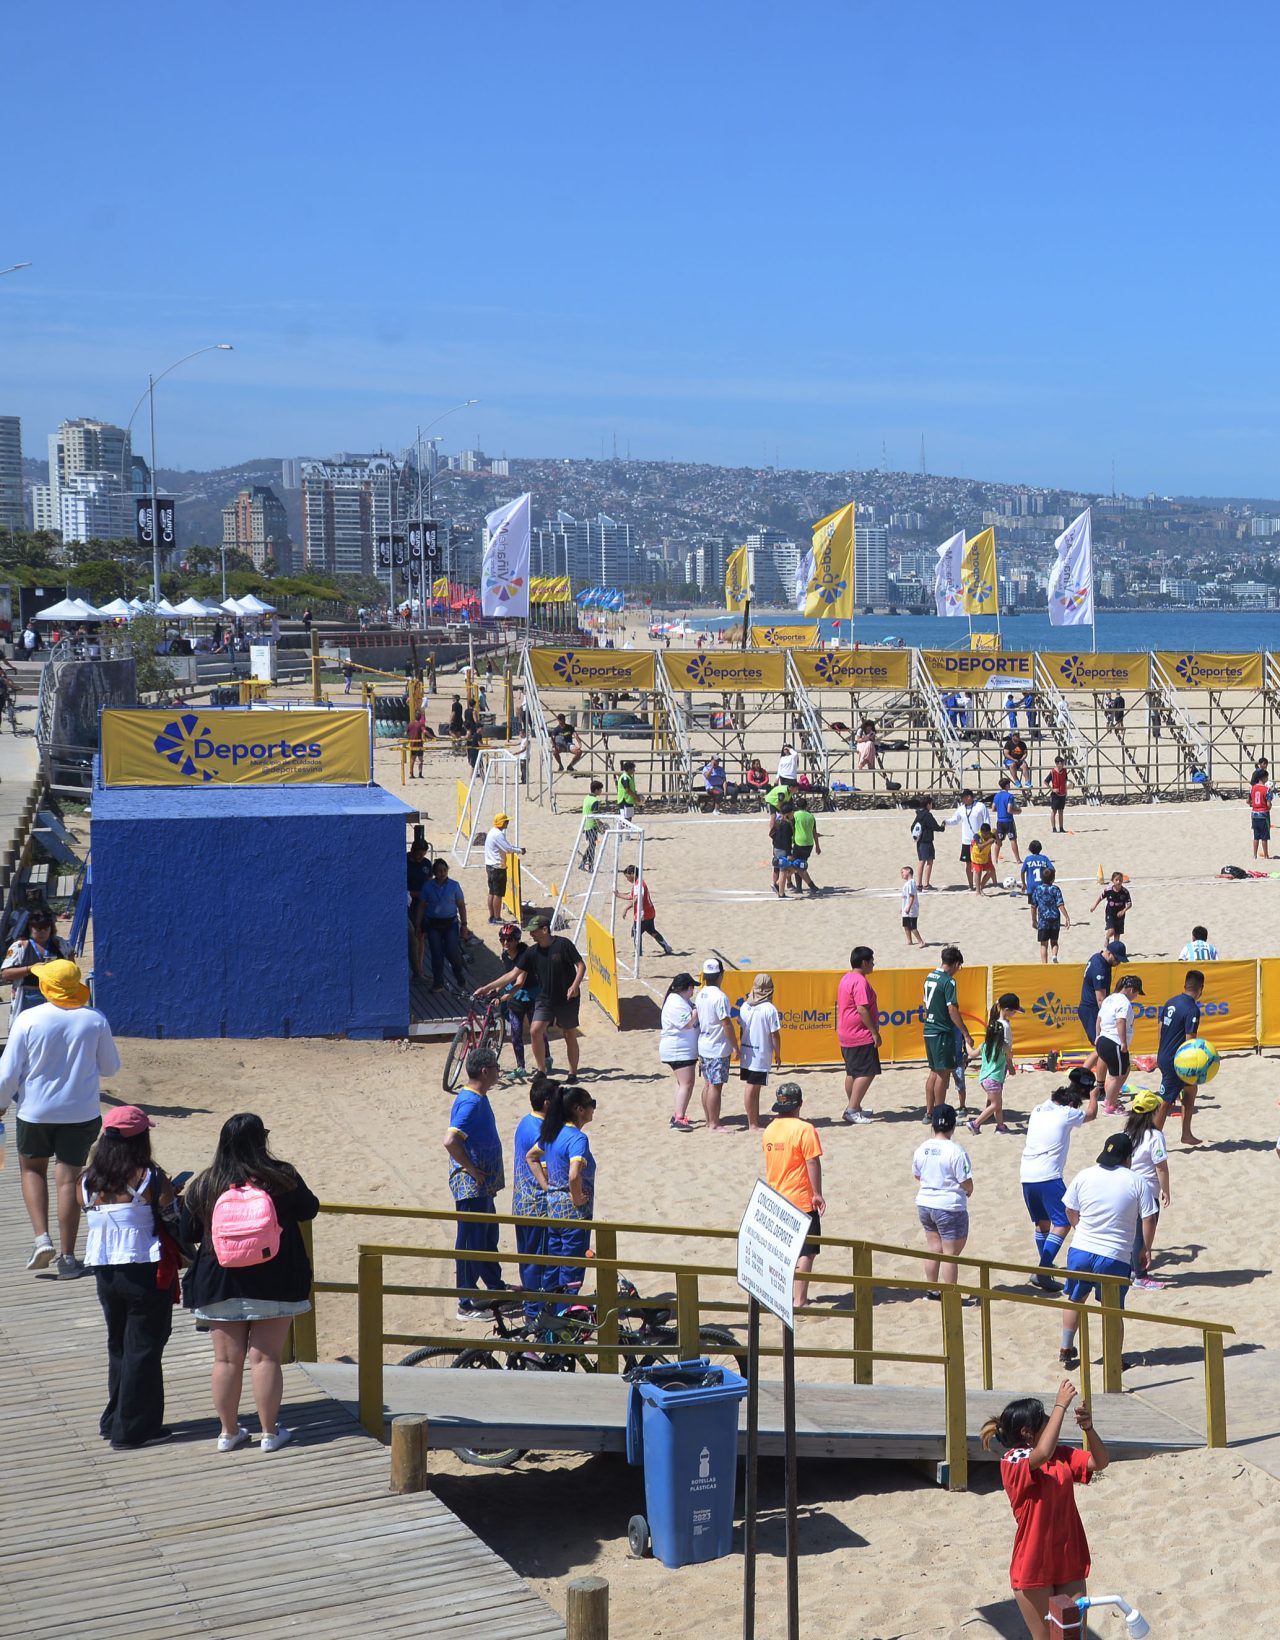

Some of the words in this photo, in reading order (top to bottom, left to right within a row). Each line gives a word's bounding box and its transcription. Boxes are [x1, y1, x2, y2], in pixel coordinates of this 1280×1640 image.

[571, 664, 632, 678] Deportes
[831, 664, 888, 678] Deportes
[945, 657, 1030, 672] DEPORTE
[1076, 665, 1129, 678] Deportes
[1191, 665, 1243, 678] Deportes
[703, 665, 763, 680] Deportes
[193, 738, 322, 766] Deportes
[878, 1004, 926, 1027] port
